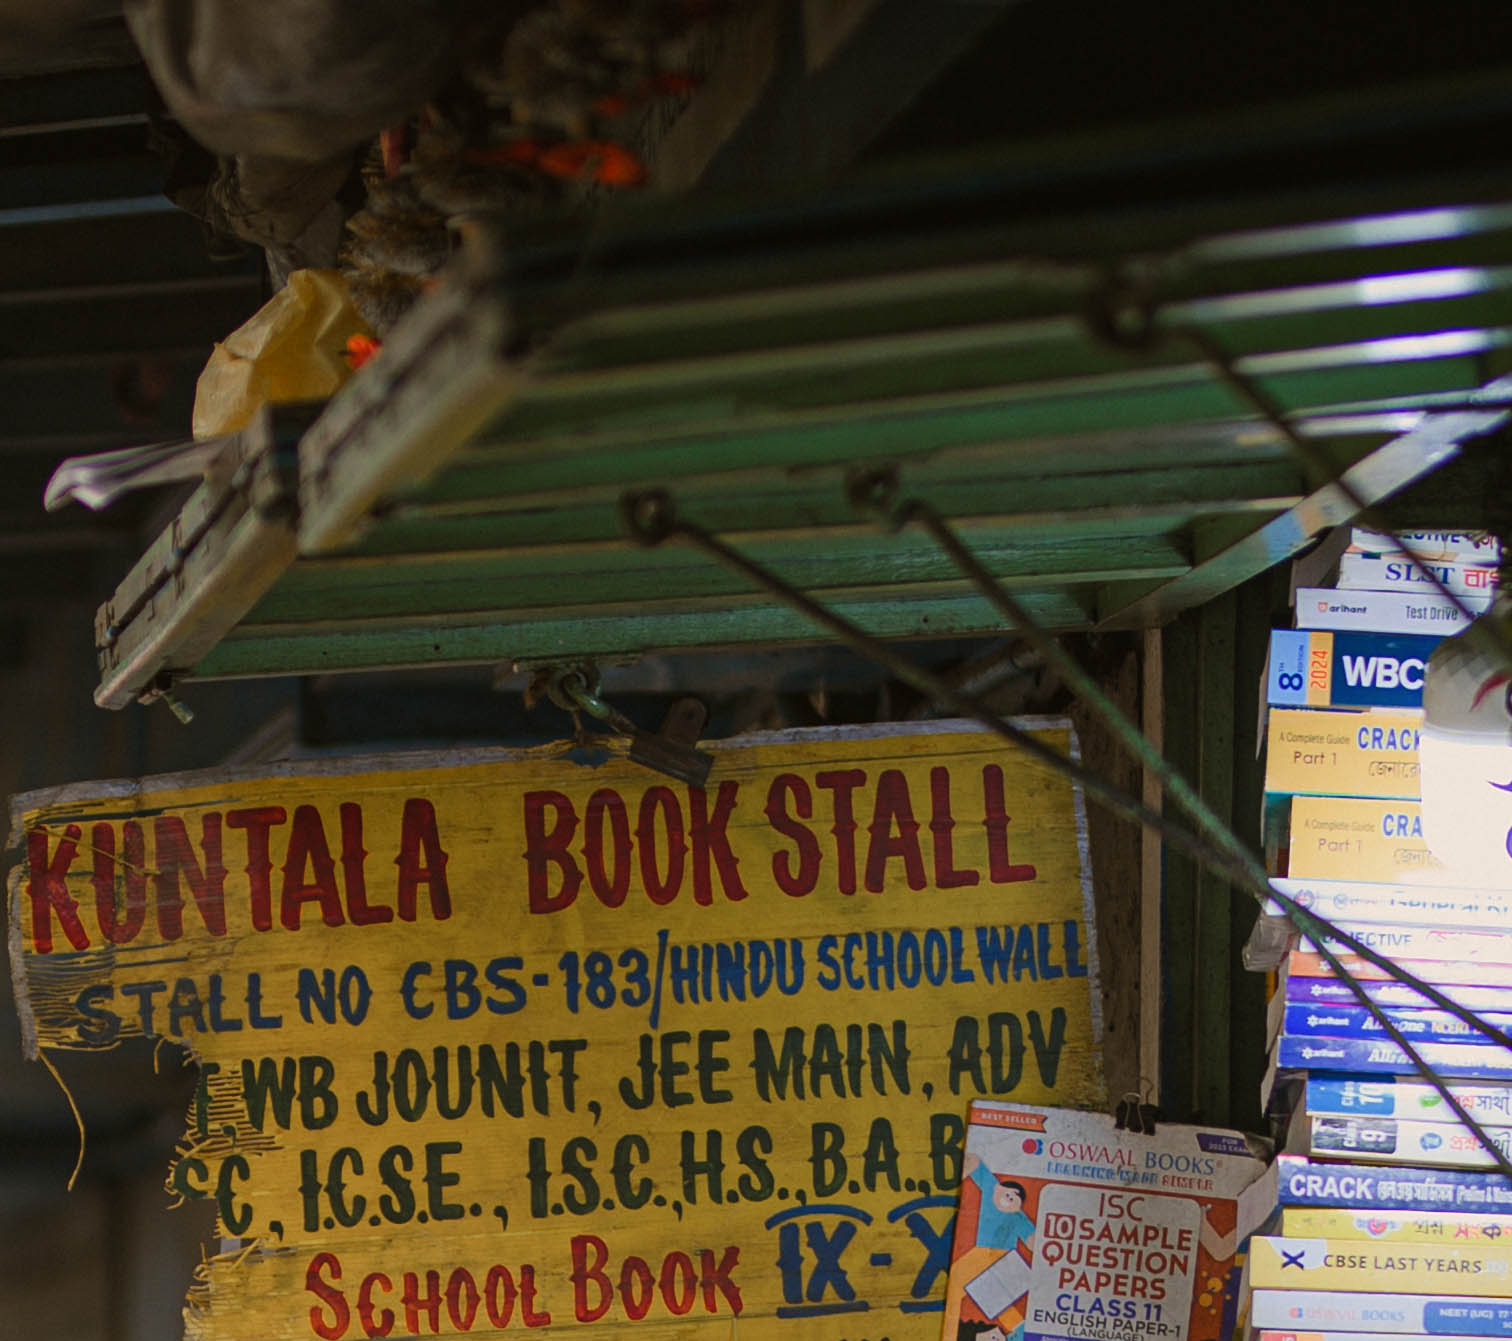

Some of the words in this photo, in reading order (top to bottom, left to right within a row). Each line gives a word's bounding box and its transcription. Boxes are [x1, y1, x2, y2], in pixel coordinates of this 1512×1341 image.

[1330, 605, 1367, 614] arihant
[1406, 606, 1427, 620] Test
[1429, 605, 1458, 621] Drive
[1279, 673, 1303, 691] 8
[1311, 650, 1328, 689] 2024
[1342, 654, 1431, 690] WBC
[1287, 732, 1324, 745] Complete
[1327, 733, 1350, 745] Guide
[1293, 751, 1326, 765] Part
[1312, 819, 1349, 832] Complete
[1382, 814, 1422, 837] CRA
[27, 798, 452, 954] KUNTALA
[523, 780, 749, 914] BOOK
[764, 764, 1036, 897] STALL
[1318, 838, 1350, 851] Part
[76, 972, 282, 1043] STALL
[298, 965, 373, 1026] NO
[818, 926, 974, 991] SCHOOL
[975, 920, 1088, 984] WALL
[356, 1039, 603, 1126] JOUNIT,
[619, 1030, 733, 1109] JEE
[748, 1020, 934, 1102] MAIN,
[948, 1007, 1068, 1096] ADV
[1049, 1141, 1136, 1167] OSWAAL
[1145, 1151, 1214, 1175] BOOKS
[1047, 1161, 1116, 1179] LEARNING
[1161, 1175, 1213, 1191] SIMPLE
[1289, 1174, 1374, 1200] CRACK
[1099, 1193, 1144, 1221] ISC
[1045, 1214, 1074, 1239] 10
[1079, 1219, 1193, 1251] SAMPLE
[1041, 1240, 1188, 1276] QUESTION
[1324, 1254, 1367, 1269] CBSE
[1373, 1256, 1417, 1270] LAST
[1425, 1257, 1482, 1273] YEARS
[305, 1252, 551, 1341] SCHOOL
[570, 1236, 744, 1322] BOOK
[1058, 1268, 1166, 1300] PAPERS
[1056, 1293, 1137, 1318] CLASS
[1143, 1304, 1162, 1322] 11
[1440, 1308, 1468, 1318] NEET
[1033, 1309, 1107, 1329] ENGLISH
[1113, 1318, 1180, 1339] PAPER-1
